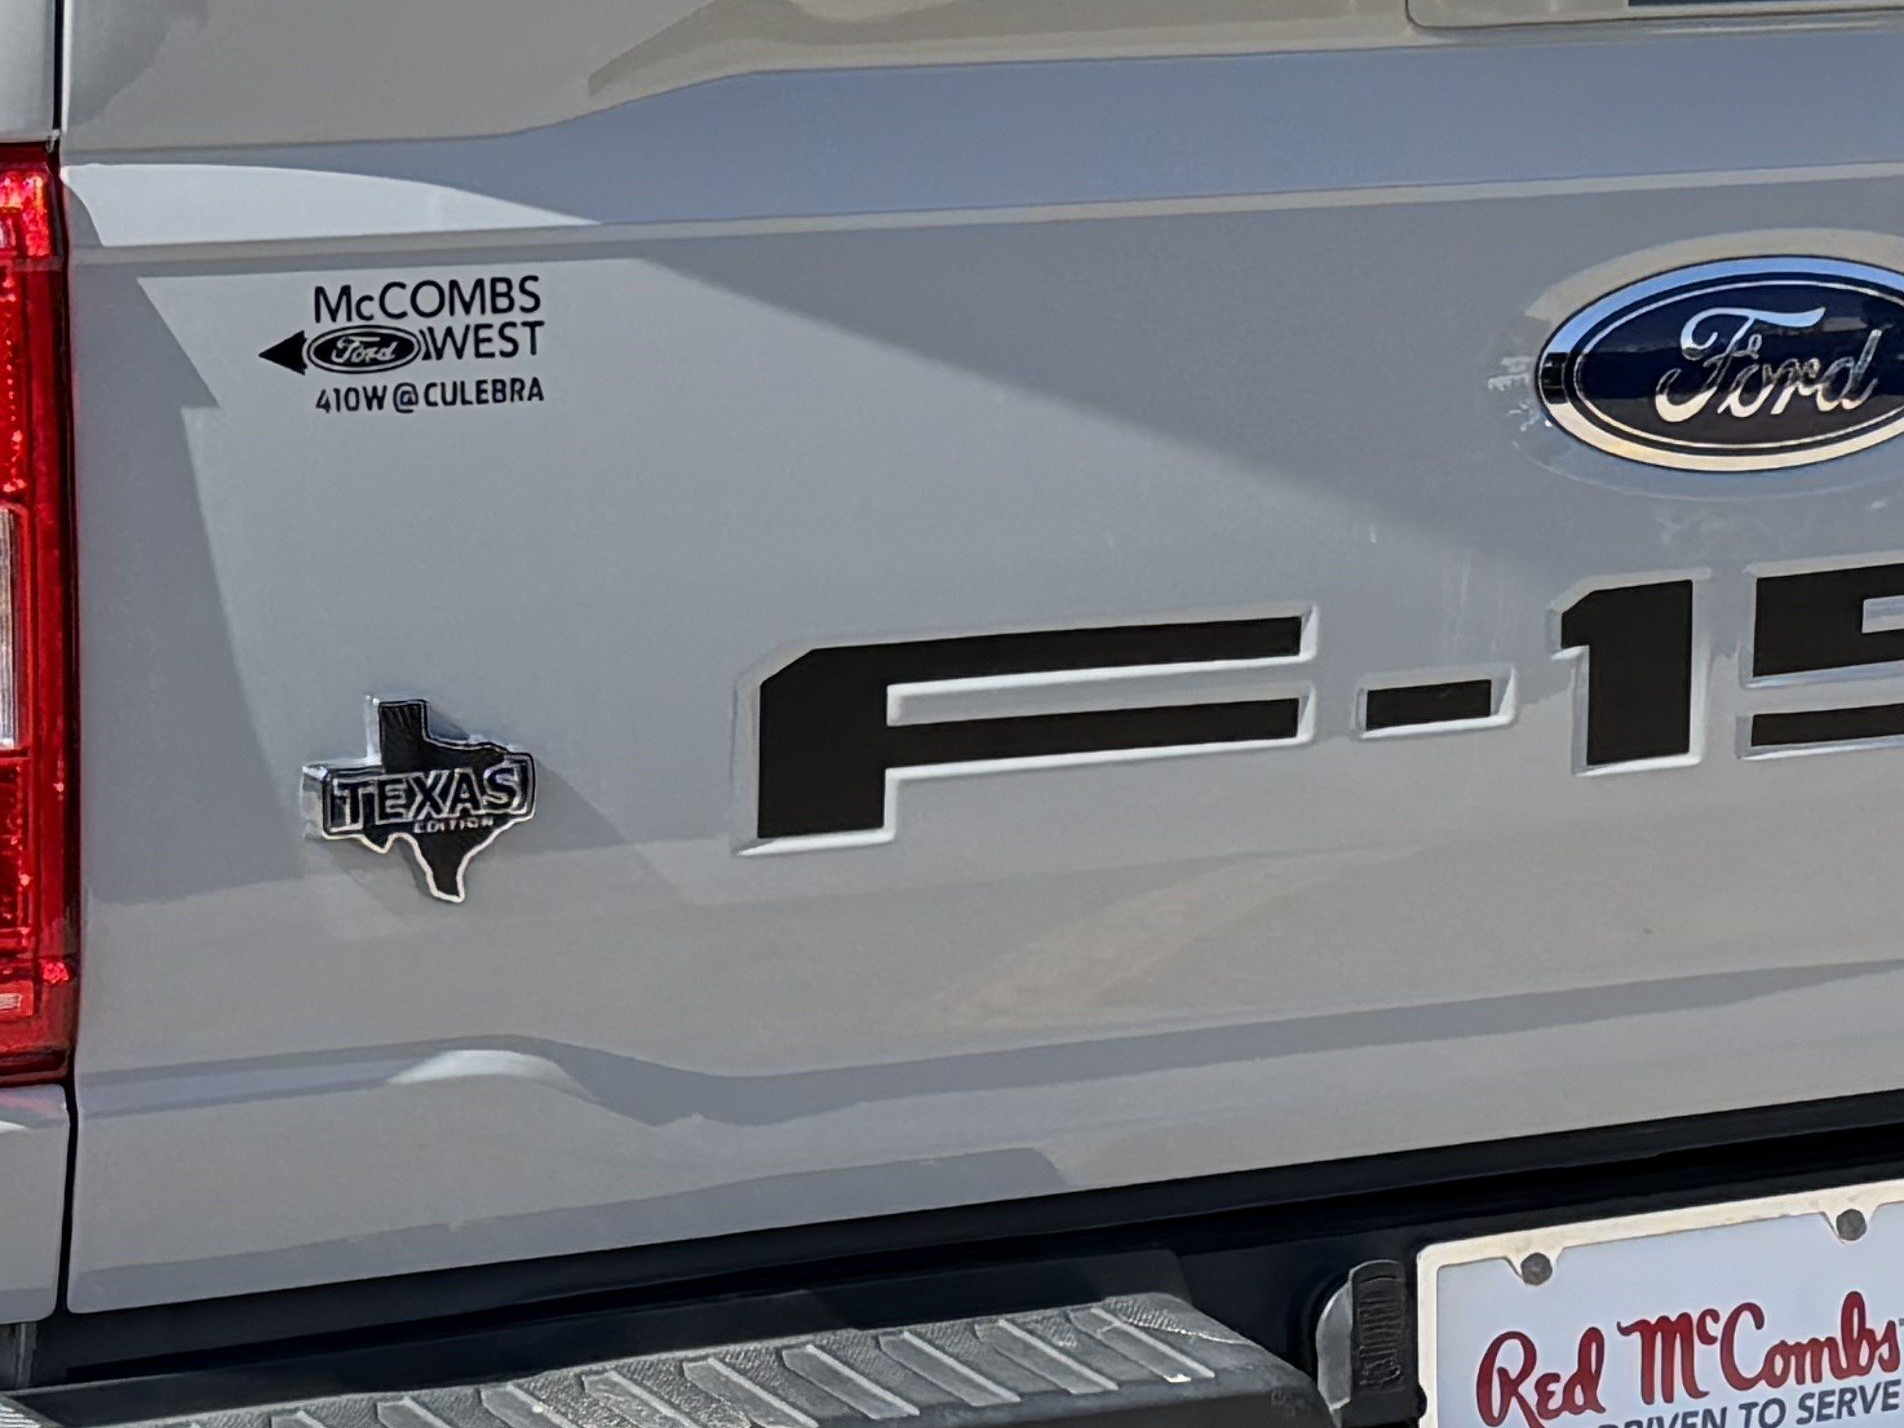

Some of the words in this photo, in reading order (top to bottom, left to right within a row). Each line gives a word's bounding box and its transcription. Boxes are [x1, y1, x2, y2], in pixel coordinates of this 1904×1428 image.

[314, 275, 541, 323] McCOMBS
[331, 336, 399, 363] Ford
[426, 321, 545, 360] WEST
[1655, 306, 1884, 422] Ford
[333, 768, 527, 832] TEXAS
[413, 817, 494, 834] EDITION
[1617, 1290, 1902, 1405] McCombs
[1797, 1379, 1902, 1426] SERVE
